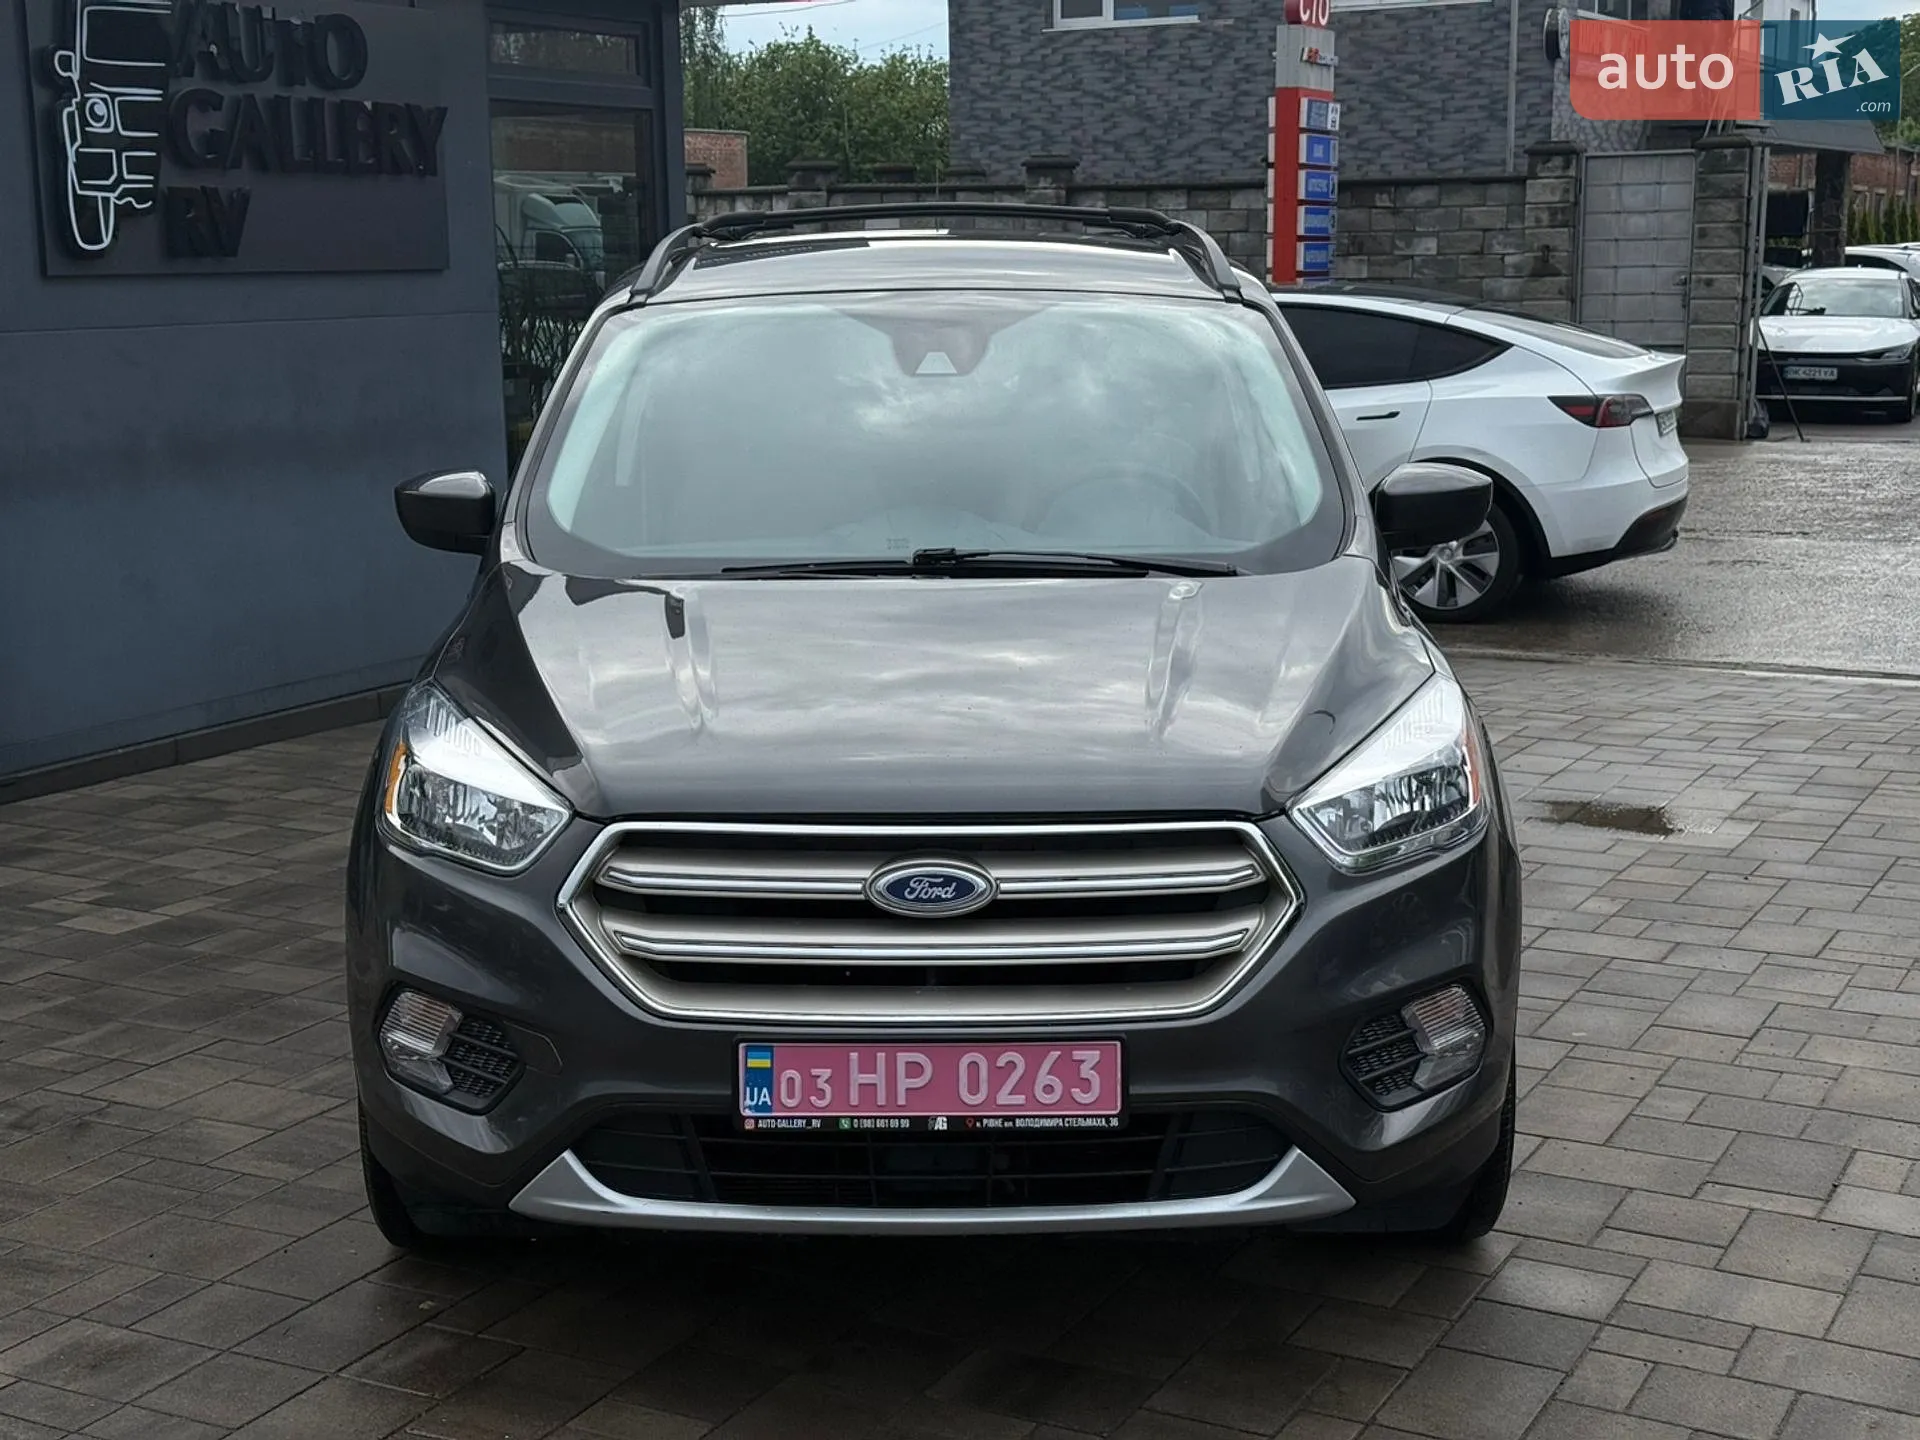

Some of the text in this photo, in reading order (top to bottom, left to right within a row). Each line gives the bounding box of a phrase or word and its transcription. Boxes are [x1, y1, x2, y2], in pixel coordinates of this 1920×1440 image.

[175, 0, 368, 89] AUTO
[166, 88, 448, 176] GALLERY
[166, 186, 250, 257] RV
[904, 876, 957, 899] Ford
[744, 1087, 772, 1106] UA
[780, 1050, 1100, 1108] 03 HP 0263
